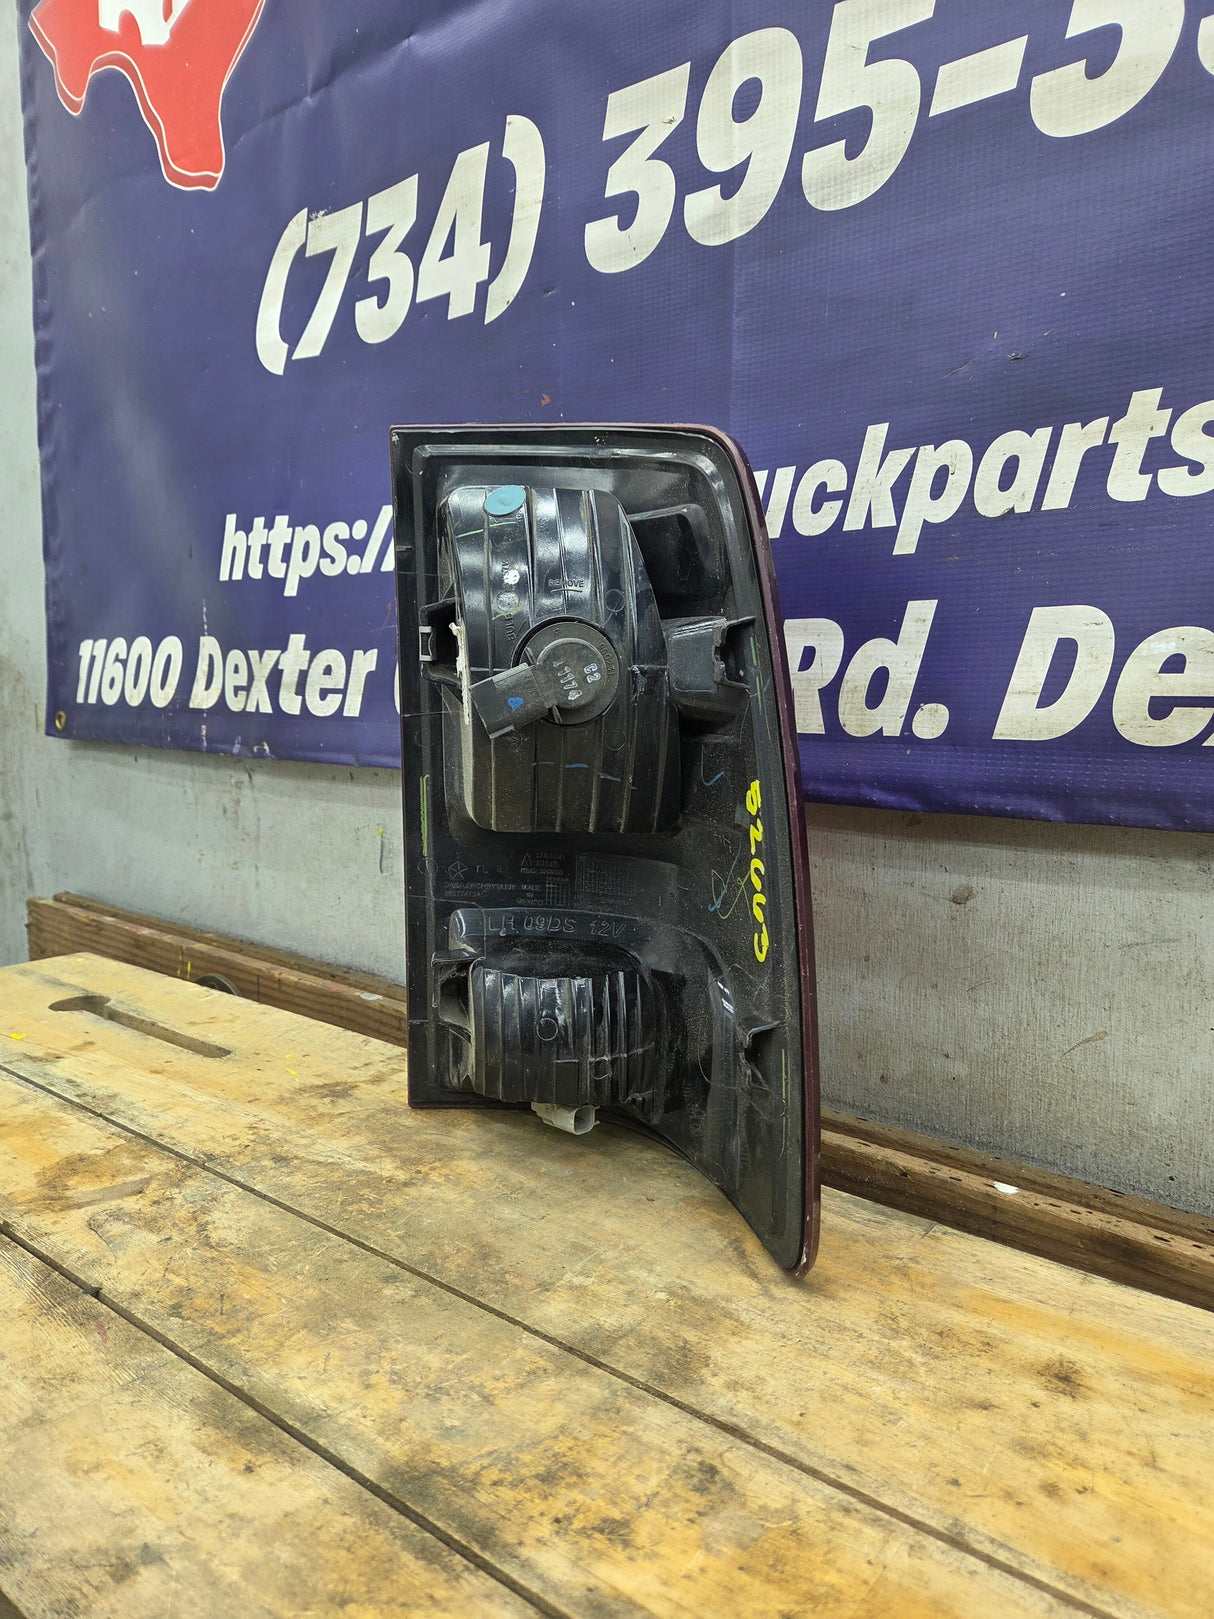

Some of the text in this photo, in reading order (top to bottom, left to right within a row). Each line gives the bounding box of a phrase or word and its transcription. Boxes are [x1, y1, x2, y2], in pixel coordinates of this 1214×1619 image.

[255, 115, 546, 376] (734)
[548, 578, 585, 588] REMOVE
[76, 636, 183, 708] 11600
[189, 632, 378, 718] Dexter
[783, 599, 950, 740] Rd.
[992, 605, 1214, 747] De
[584, 663, 601, 683] C2
[488, 913, 516, 932] LH
[589, 919, 629, 939] 12V
